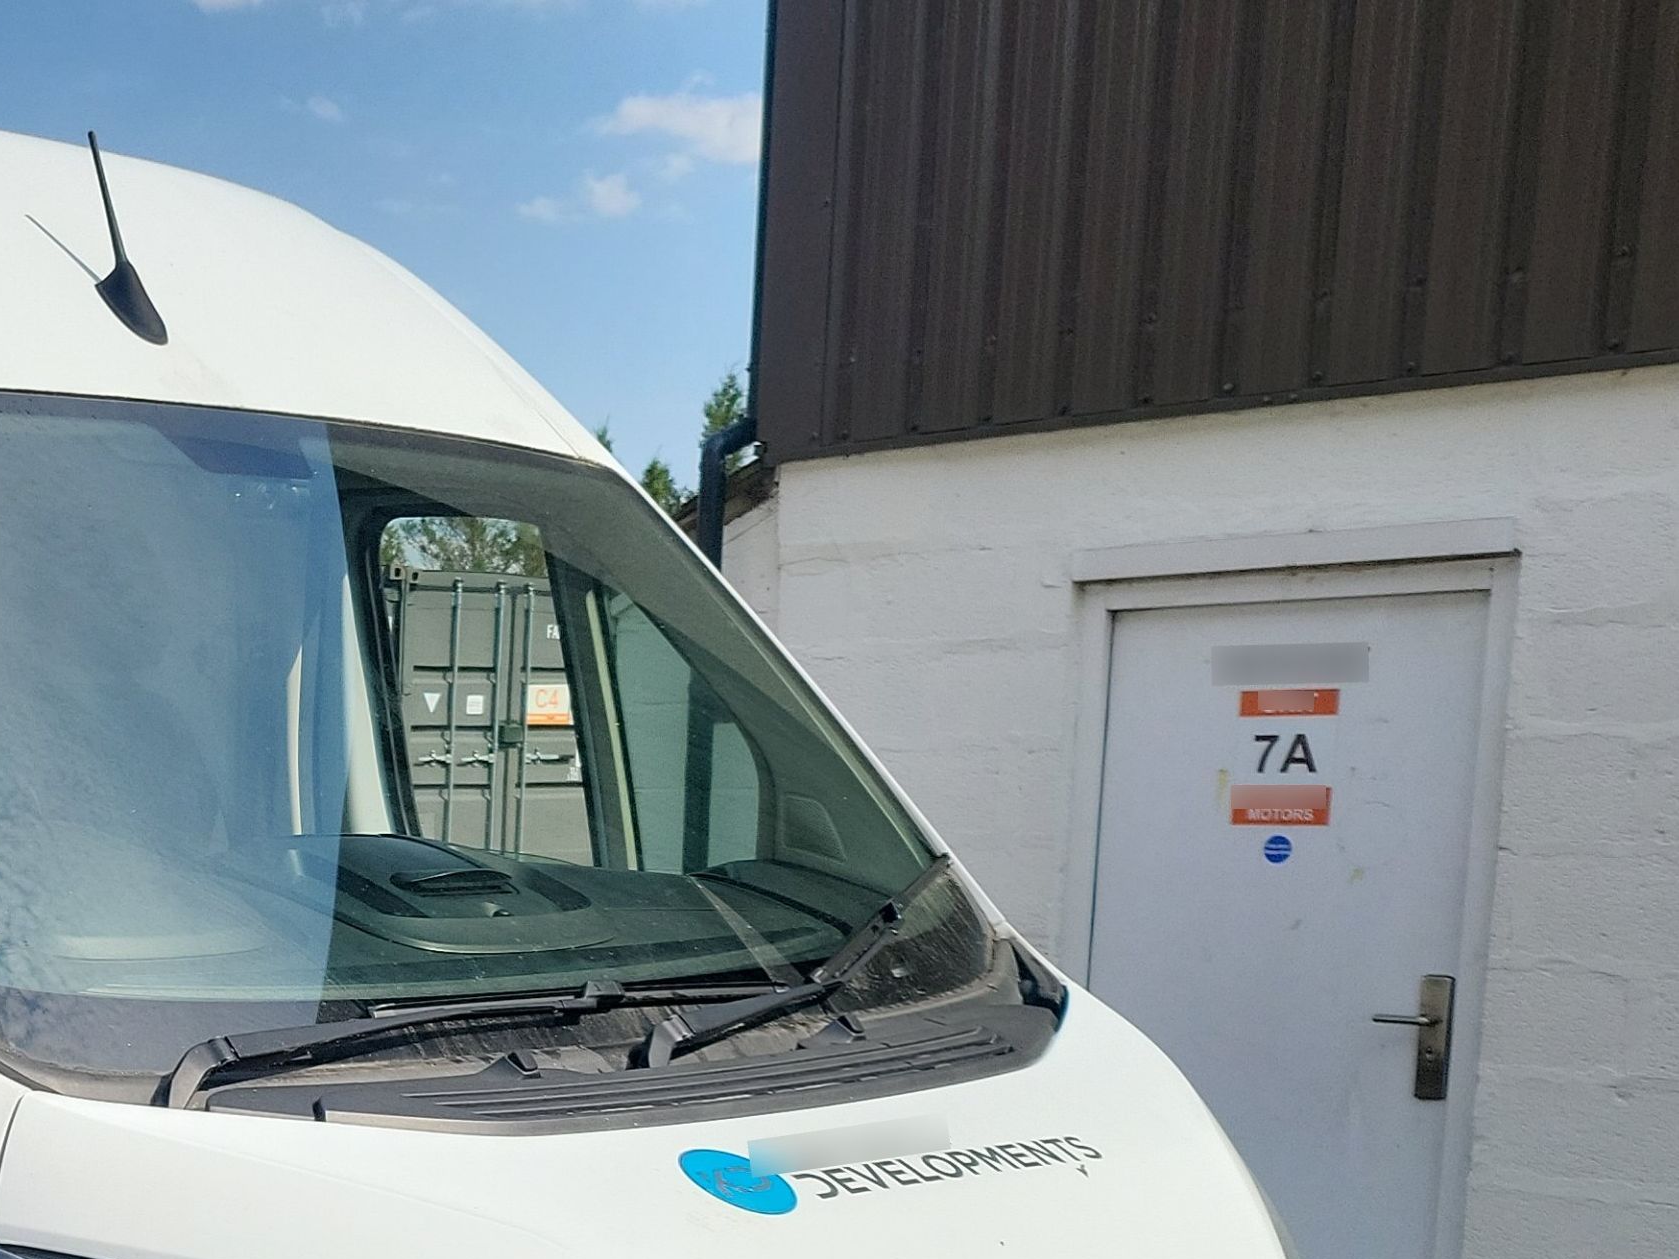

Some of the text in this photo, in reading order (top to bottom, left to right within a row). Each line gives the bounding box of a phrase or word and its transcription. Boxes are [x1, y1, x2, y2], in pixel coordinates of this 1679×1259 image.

[535, 689, 560, 708] C4
[1254, 733, 1317, 773] 7A
[1248, 808, 1314, 821] MOTORS
[791, 1136, 1102, 1199] DEVELOPMENTS
